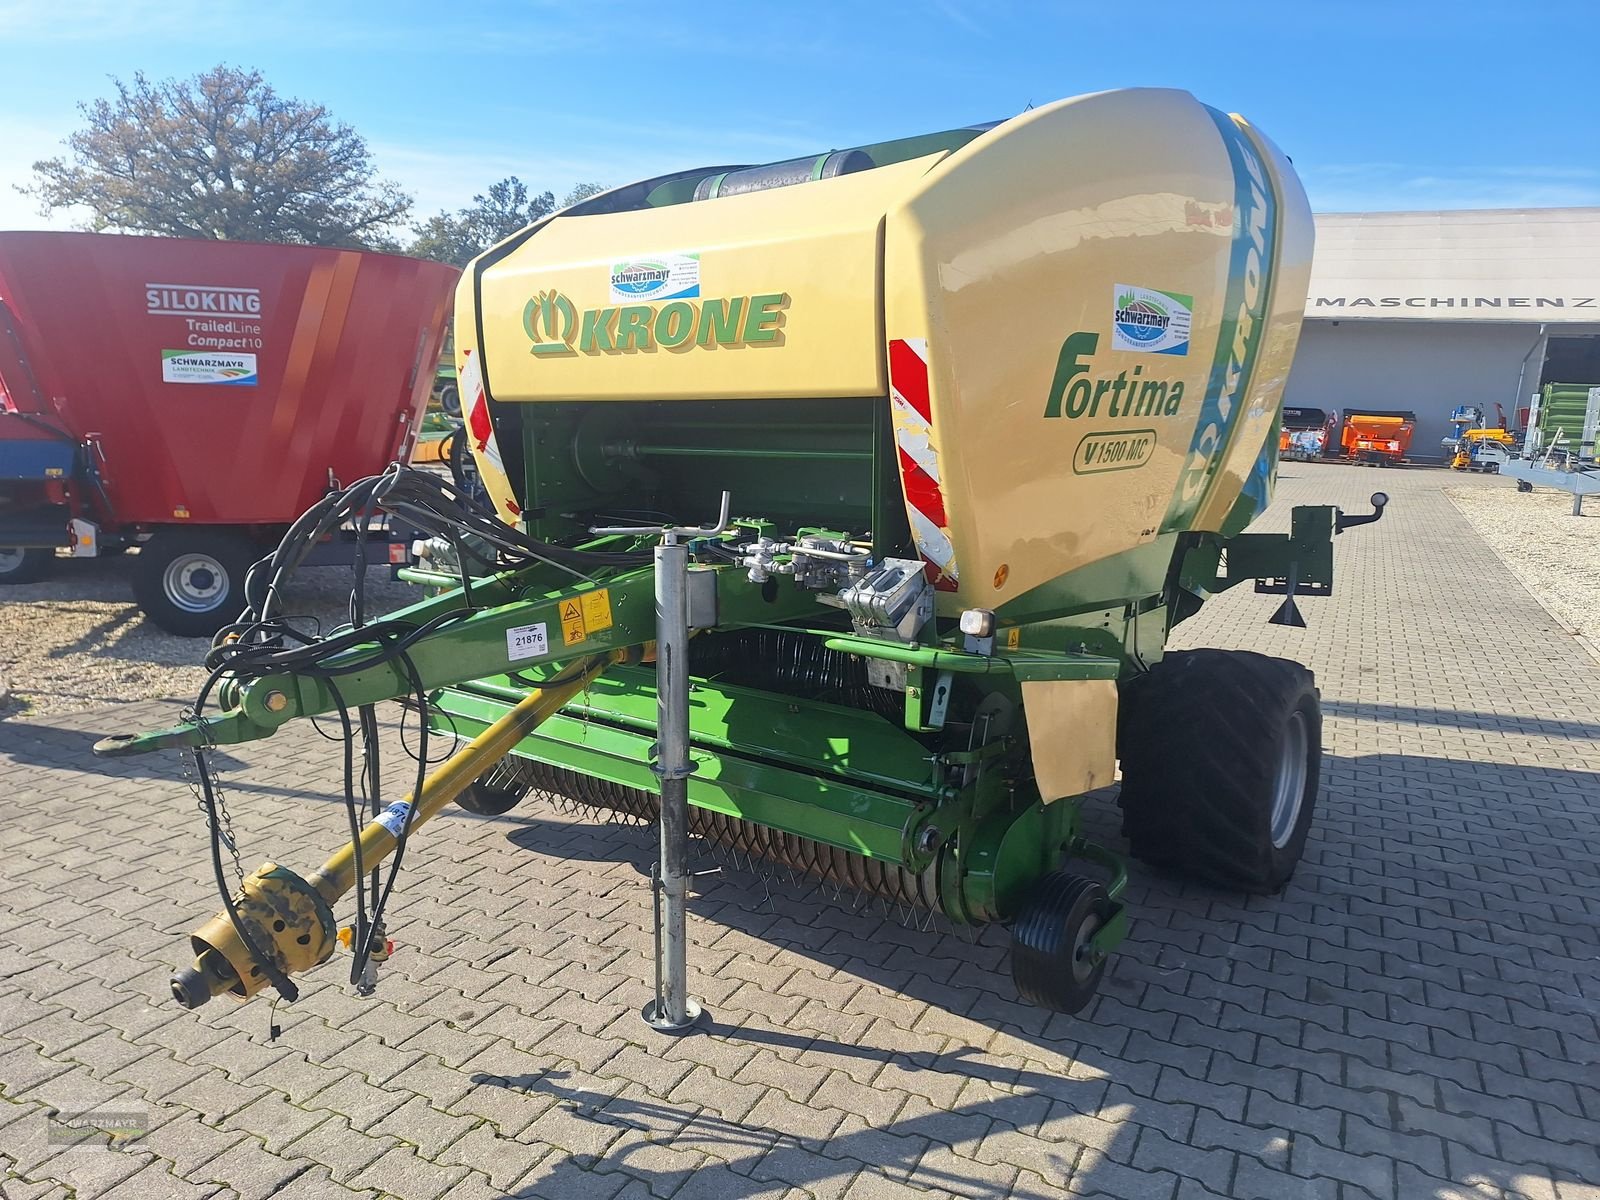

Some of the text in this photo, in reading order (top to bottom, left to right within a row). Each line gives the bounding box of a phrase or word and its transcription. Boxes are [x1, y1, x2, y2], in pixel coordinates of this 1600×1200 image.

[611, 269, 670, 284] schwarzmayr
[146, 289, 261, 312] SILOKING
[579, 292, 790, 357] KRONE
[1115, 307, 1170, 329] schwarzmayr
[170, 358, 244, 368] SCHWARZMAYR
[1043, 331, 1185, 419] Fortima
[1126, 439, 1148, 461] MC
[515, 633, 543, 647] 21876
